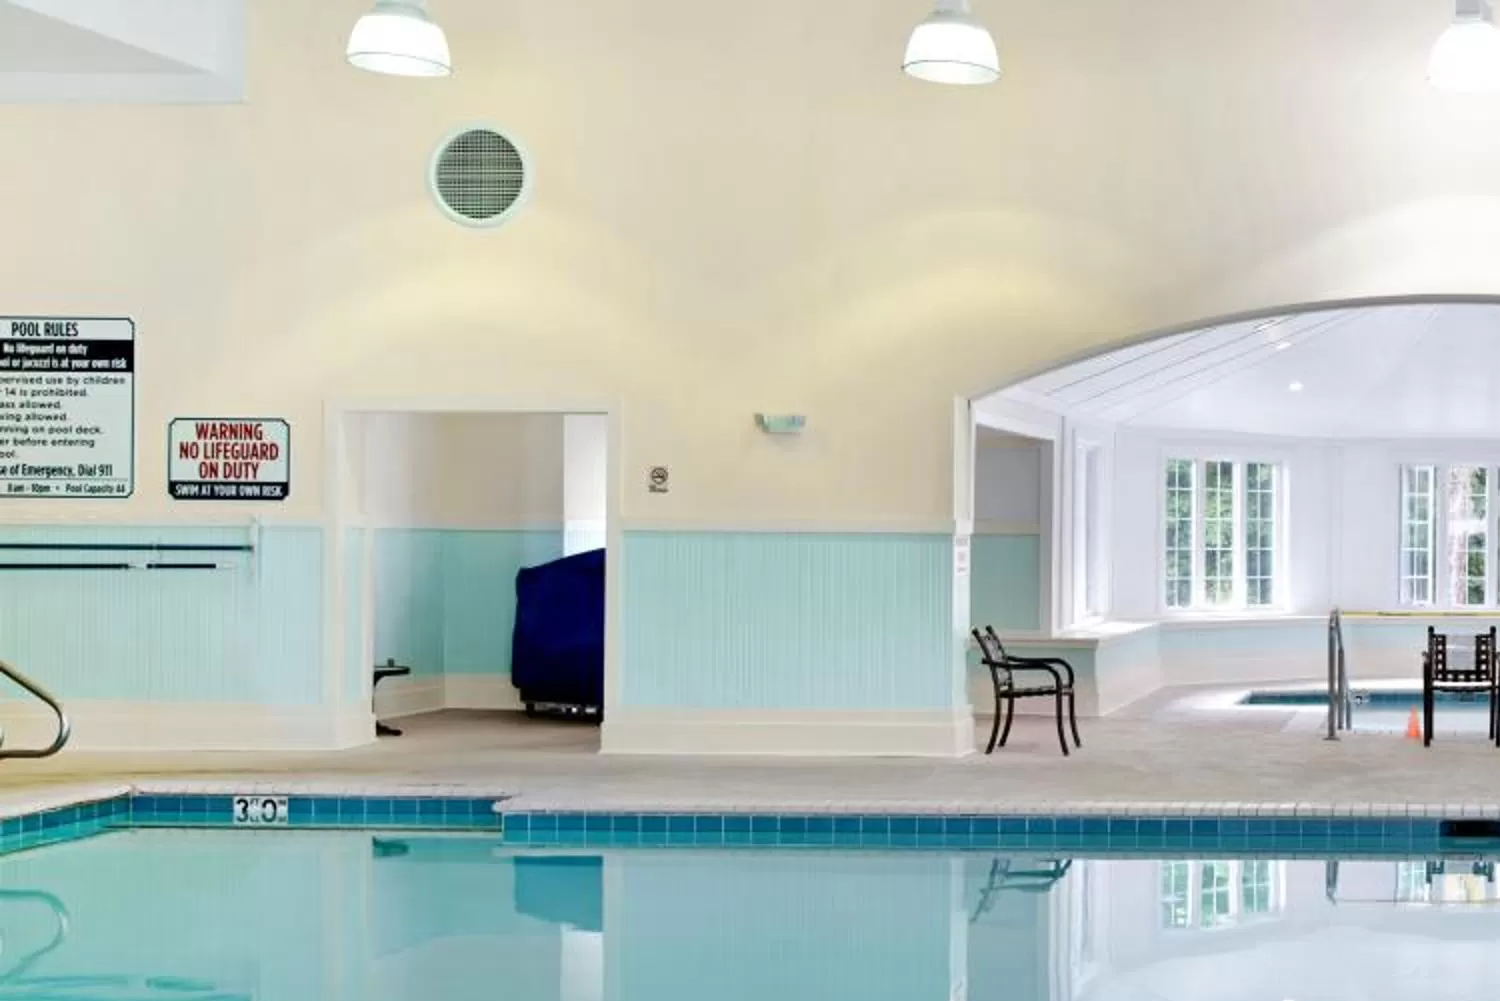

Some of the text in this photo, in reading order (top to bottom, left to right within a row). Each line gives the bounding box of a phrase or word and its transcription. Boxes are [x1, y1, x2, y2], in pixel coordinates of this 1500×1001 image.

[11, 321, 79, 337] POOL RULES
[195, 422, 264, 441] WARNING
[179, 441, 280, 461] NO LIFEGUARD
[97, 463, 113, 477] 911
[199, 461, 260, 480] ON DUTY
[175, 483, 200, 496] SWIM
[201, 484, 212, 497] AT
[213, 484, 237, 497] YOUR
[238, 485, 261, 497] OWN
